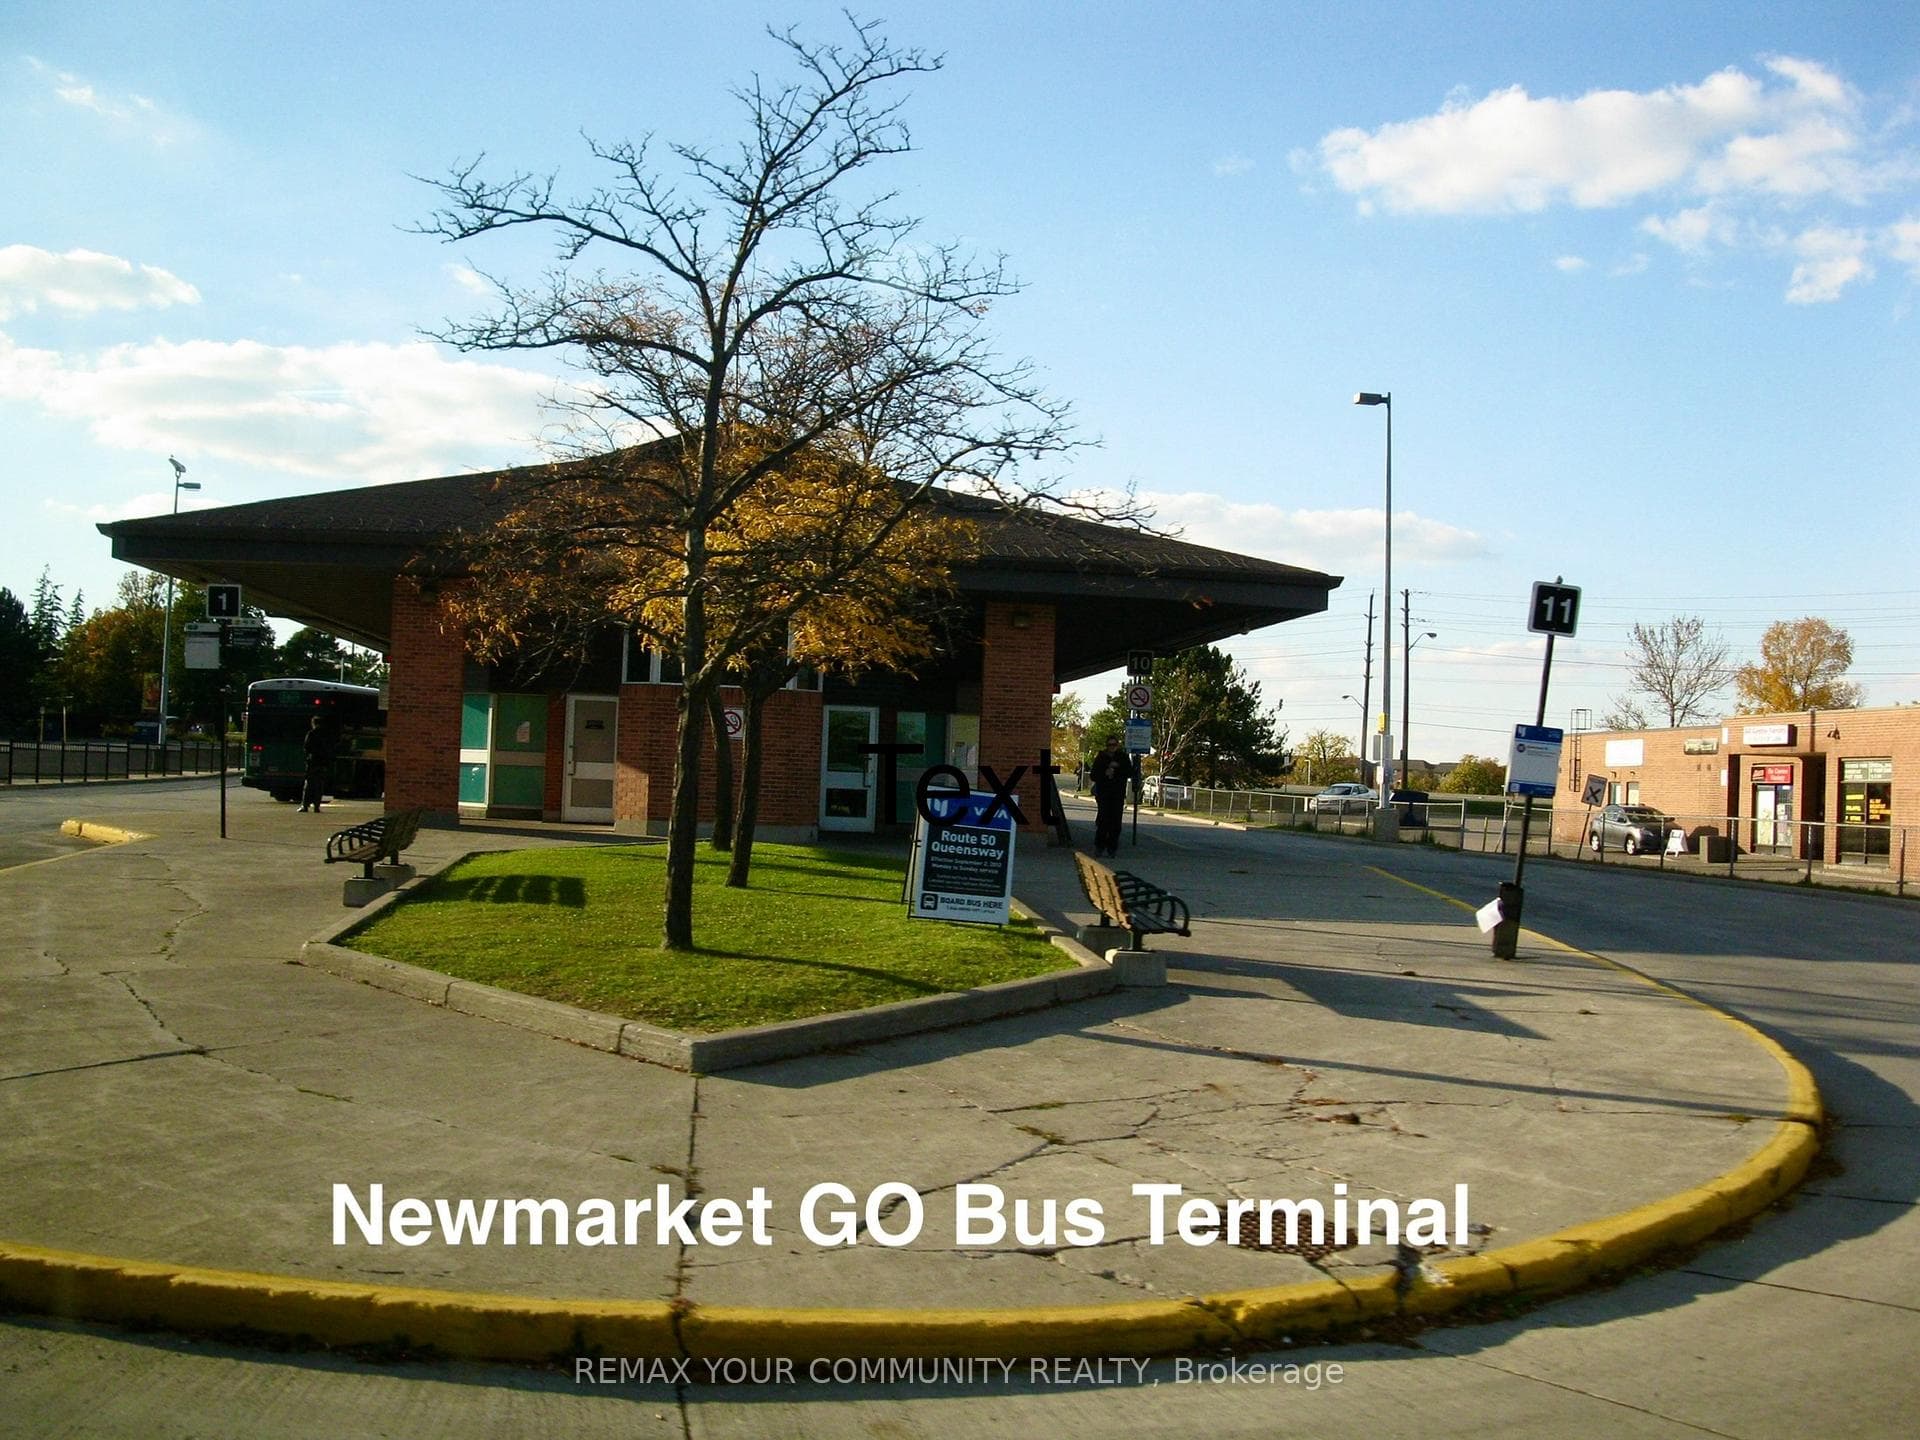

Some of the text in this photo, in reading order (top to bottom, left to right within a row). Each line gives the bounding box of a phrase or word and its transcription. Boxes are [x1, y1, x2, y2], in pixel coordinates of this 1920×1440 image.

[217, 592, 227, 611] 1
[1542, 595, 1572, 625] 11
[1131, 656, 1151, 670] 10
[941, 830, 996, 846] Route 50
[931, 841, 1004, 860] Queensway
[939, 896, 1004, 909] BOARD BUS HERE
